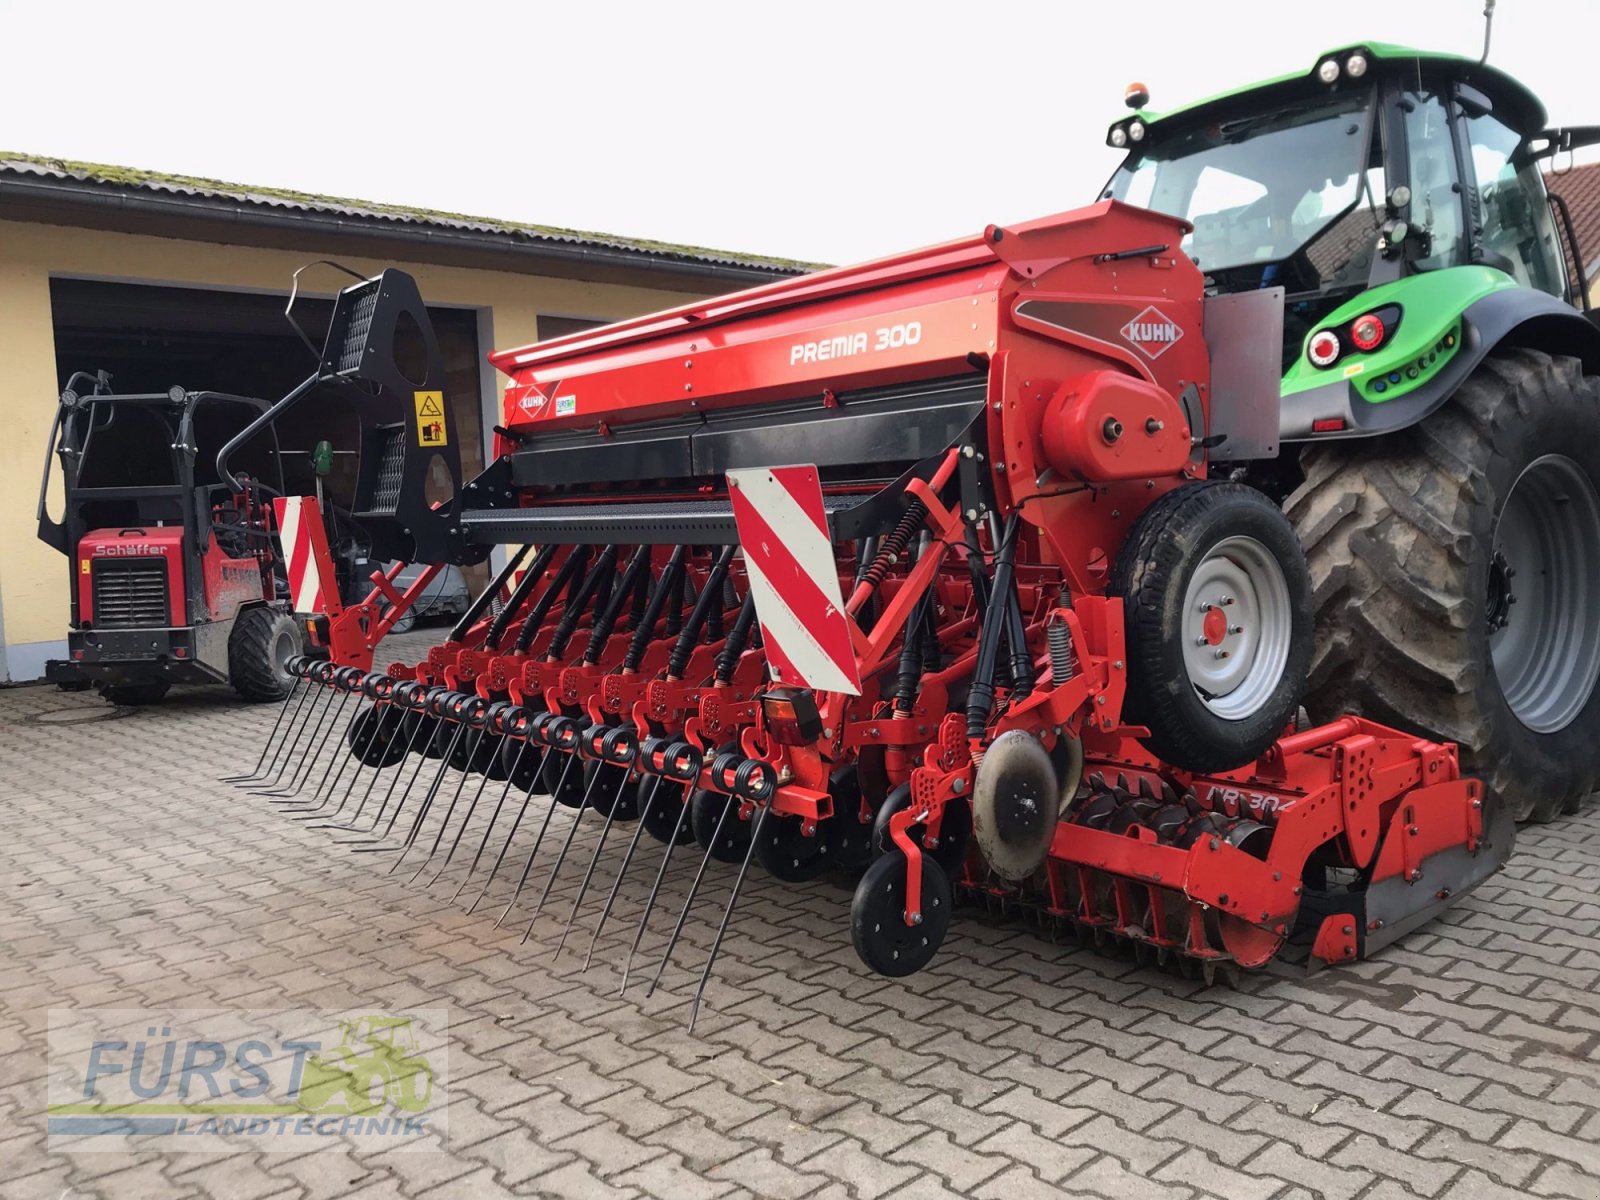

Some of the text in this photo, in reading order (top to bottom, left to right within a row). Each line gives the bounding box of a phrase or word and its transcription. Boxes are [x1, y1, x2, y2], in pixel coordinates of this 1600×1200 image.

[1129, 323, 1176, 341] KUHN
[790, 321, 921, 365] PREMIA 300
[522, 395, 544, 409] KUHN
[92, 544, 168, 556] Schäffer
